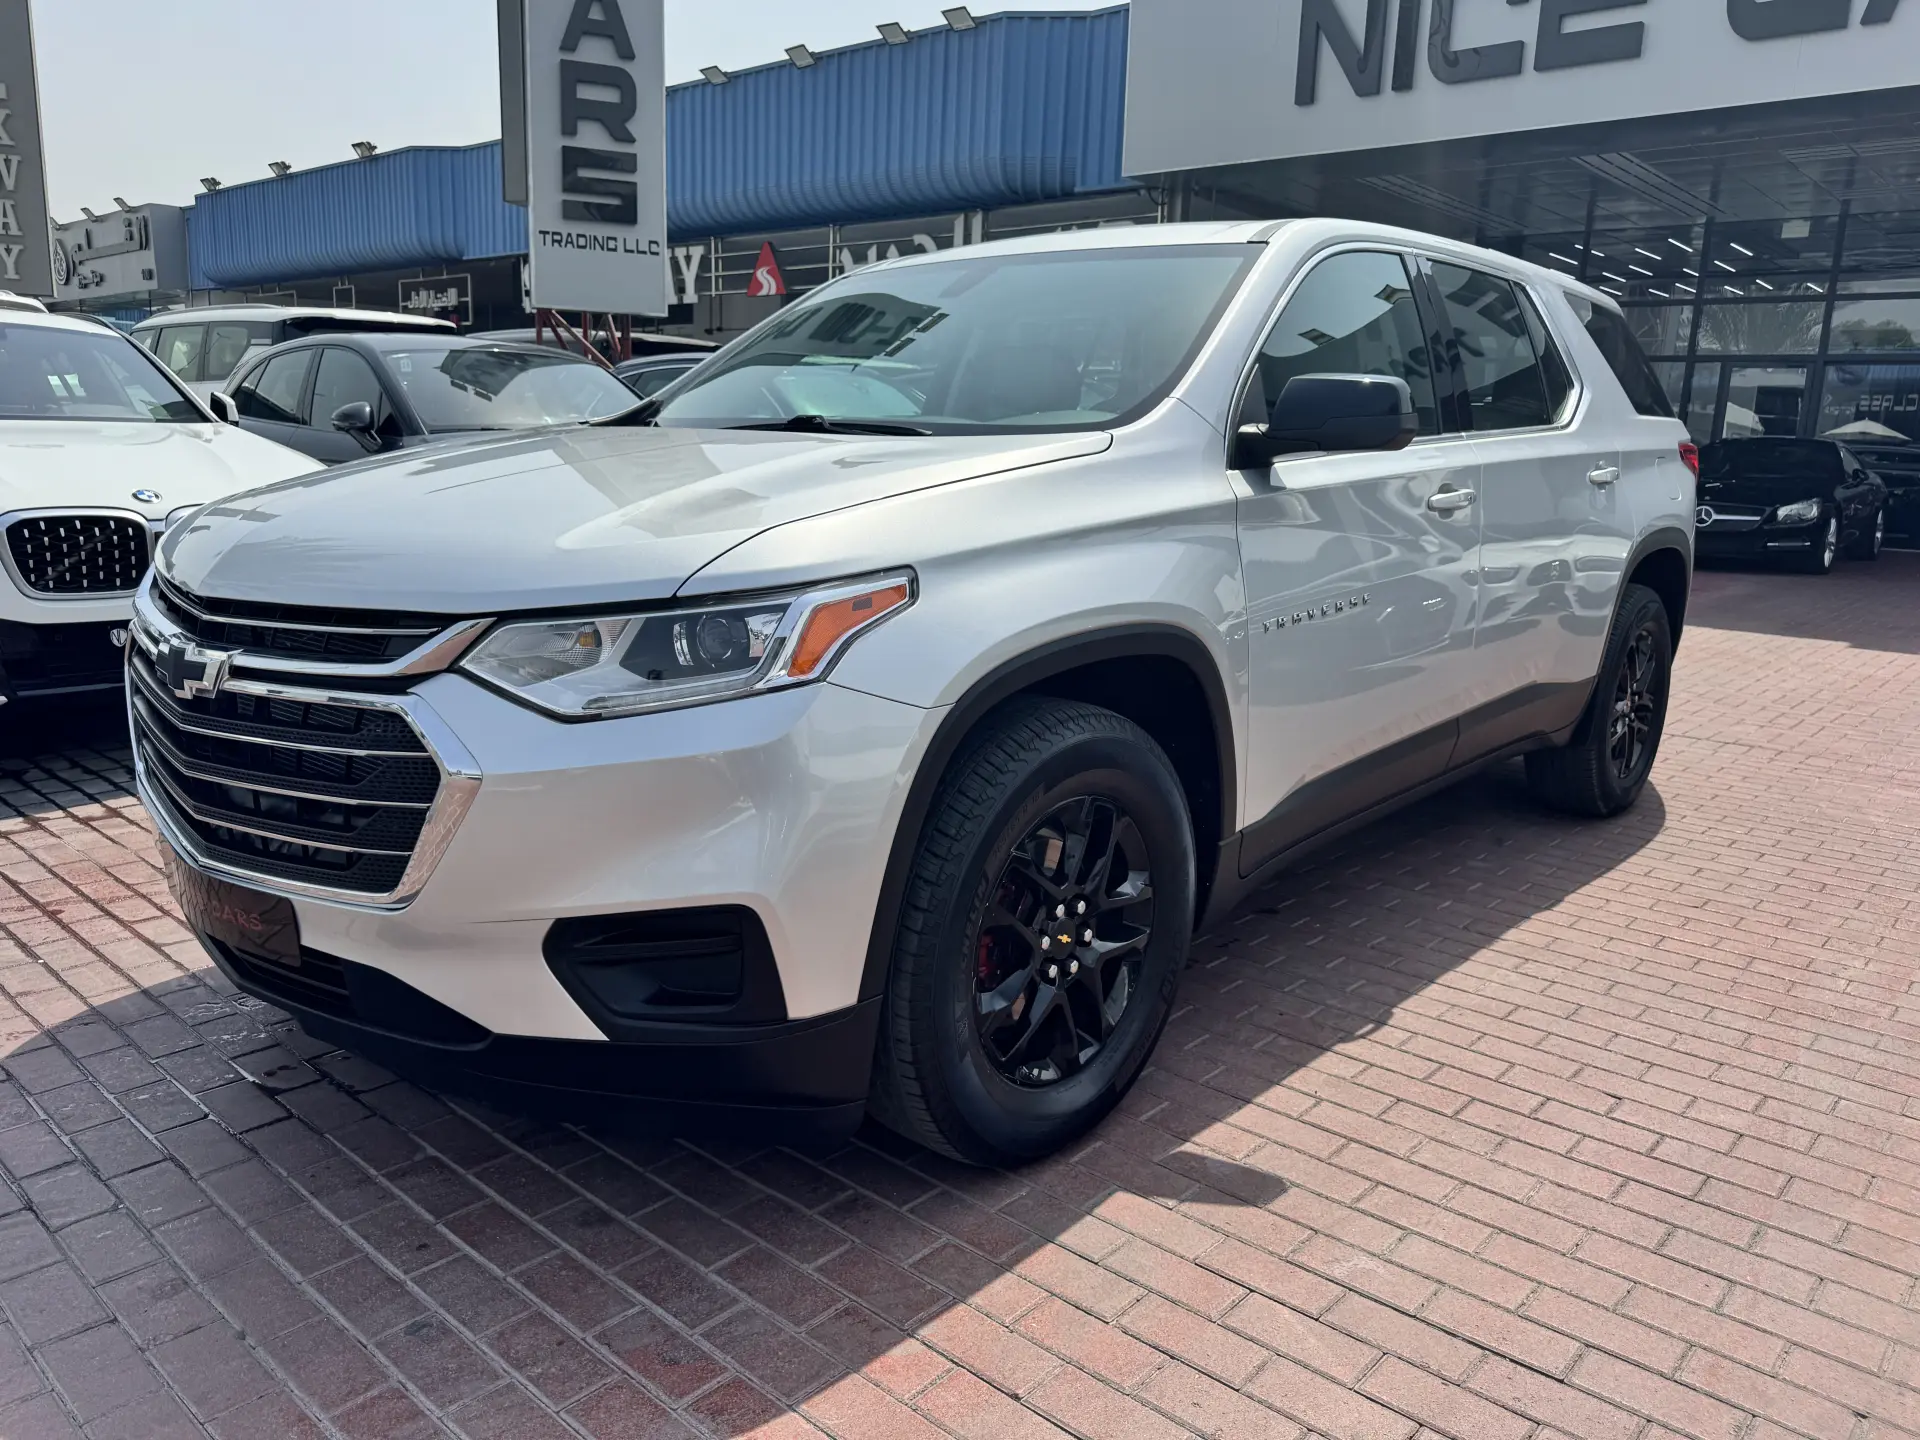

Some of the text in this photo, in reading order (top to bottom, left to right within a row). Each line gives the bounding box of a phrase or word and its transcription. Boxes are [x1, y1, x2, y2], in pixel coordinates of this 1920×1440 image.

[1294, 0, 1646, 106] NICE
[538, 230, 660, 256] TRADING LLC
[1262, 592, 1371, 633] TRAVERSE
